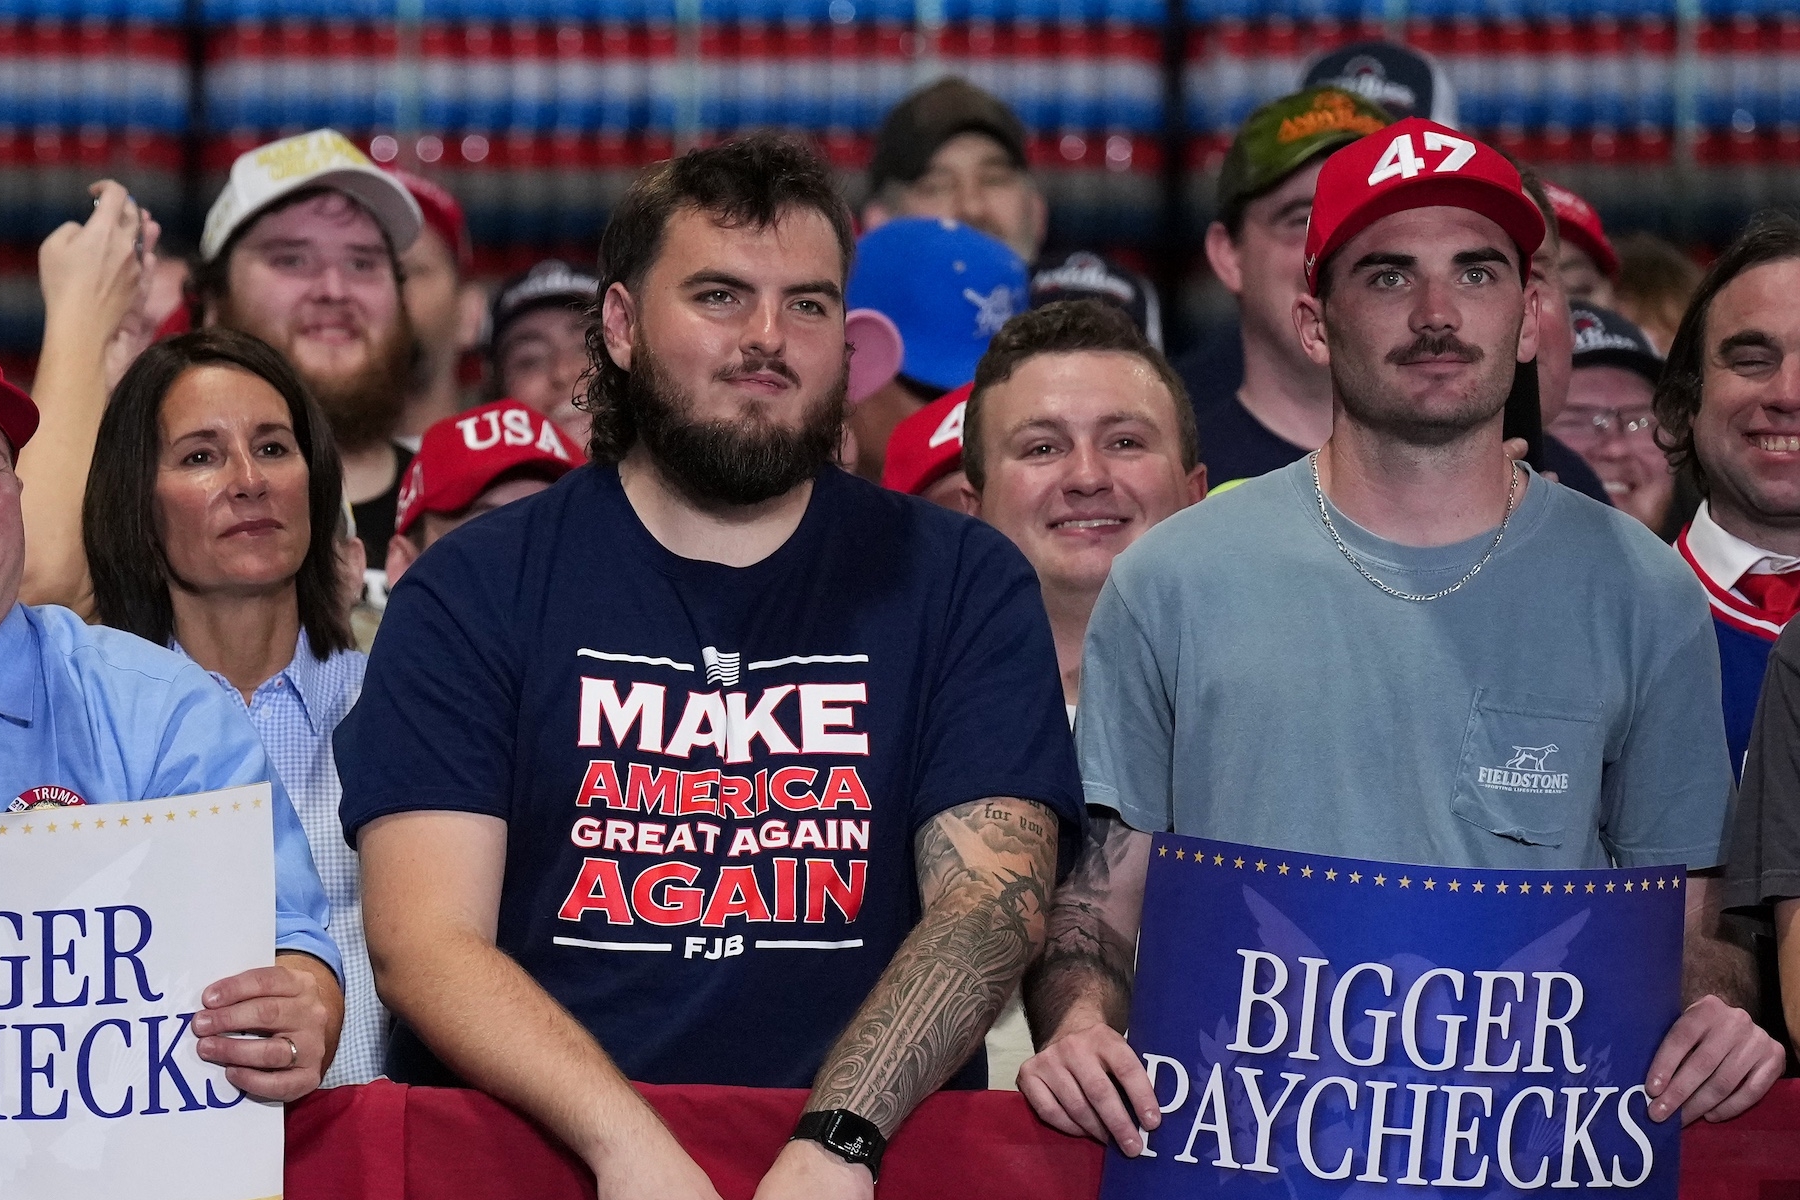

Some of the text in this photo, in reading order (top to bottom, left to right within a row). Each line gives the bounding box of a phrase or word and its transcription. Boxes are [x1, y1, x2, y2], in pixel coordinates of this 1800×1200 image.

[1368, 132, 1476, 187] 47
[455, 408, 570, 462] USA
[928, 400, 967, 448] 4
[577, 675, 870, 764] MAKE
[33, 787, 79, 805] TRUMP
[575, 759, 872, 819] AMERICA
[1478, 766, 1569, 789] FIELDSTONE
[570, 817, 870, 857] GREAT AGAIN
[558, 857, 869, 928] AGAIN
[683, 934, 744, 960] FJB
[1226, 948, 1587, 1074] BIGGER
[1138, 1051, 1656, 1190] PAYCHECKS
